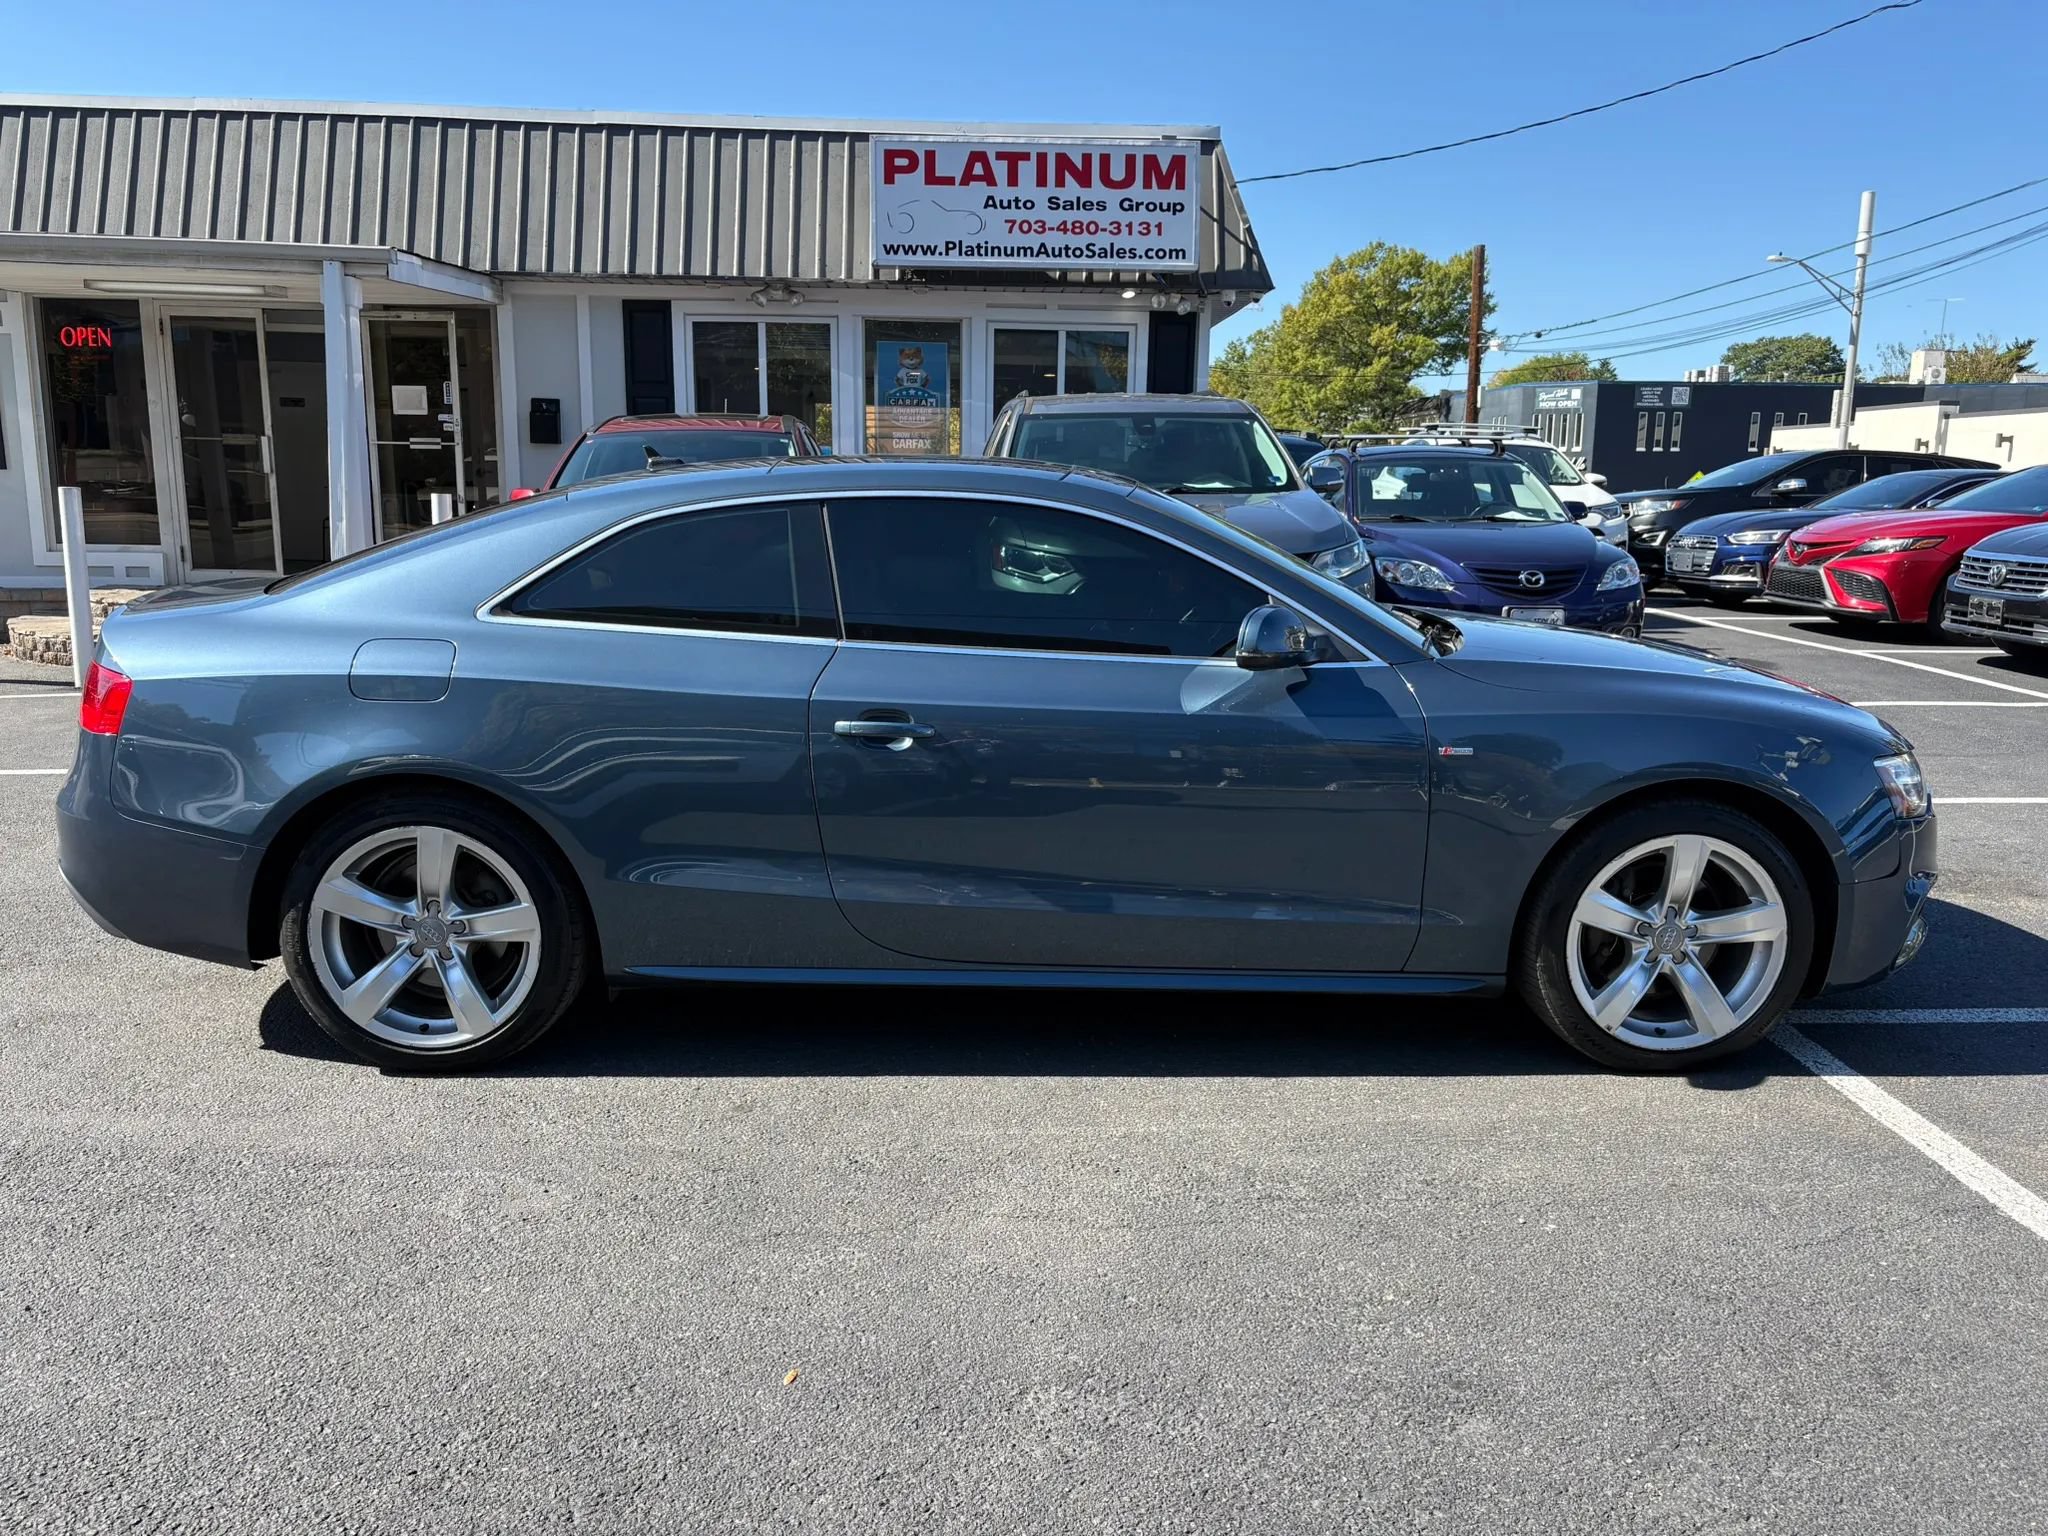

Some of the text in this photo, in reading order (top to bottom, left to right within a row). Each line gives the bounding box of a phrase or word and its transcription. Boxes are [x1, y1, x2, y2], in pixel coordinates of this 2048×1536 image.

[883, 148, 1186, 190] PLATINUM
[983, 195, 1185, 215] Auto Sales Group
[1004, 219, 1164, 236] 703-480-3131
[883, 240, 1187, 260] www.PlatinumAutoSales.com
[60, 326, 113, 348] OPEN
[892, 407, 932, 415] ADVANTAGE
[899, 415, 926, 423] DEALER
[893, 439, 931, 449] CARFAX
